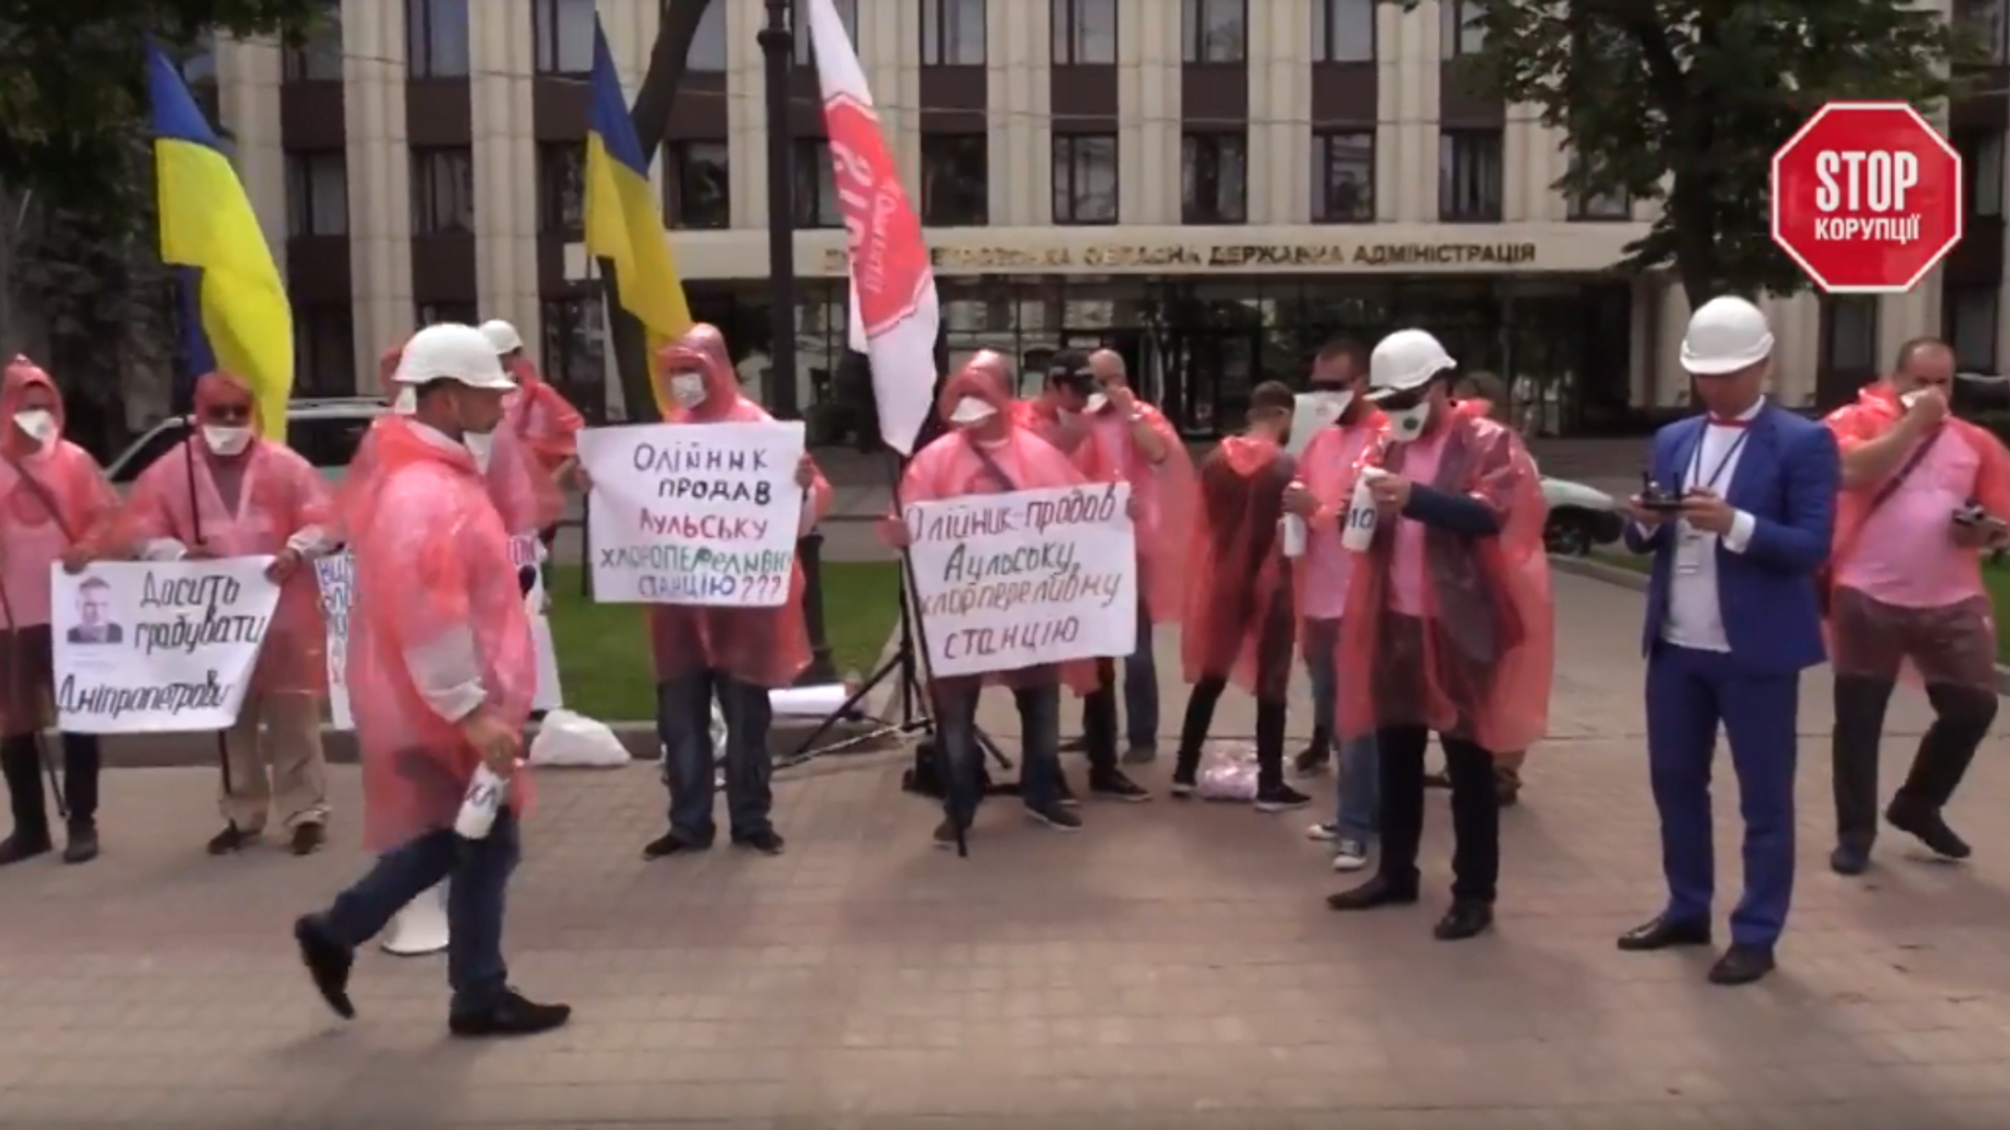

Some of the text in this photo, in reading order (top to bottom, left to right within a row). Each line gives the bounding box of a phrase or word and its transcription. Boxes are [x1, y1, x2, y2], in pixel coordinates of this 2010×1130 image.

[1353, 243, 1536, 265] АДМІНІСТРАЦІЯ
[658, 477, 772, 506] ПРОДАВ
[639, 507, 768, 541] АУЛЬСЬКУ
[140, 570, 241, 607] Досить
[134, 604, 267, 656] грабувати
